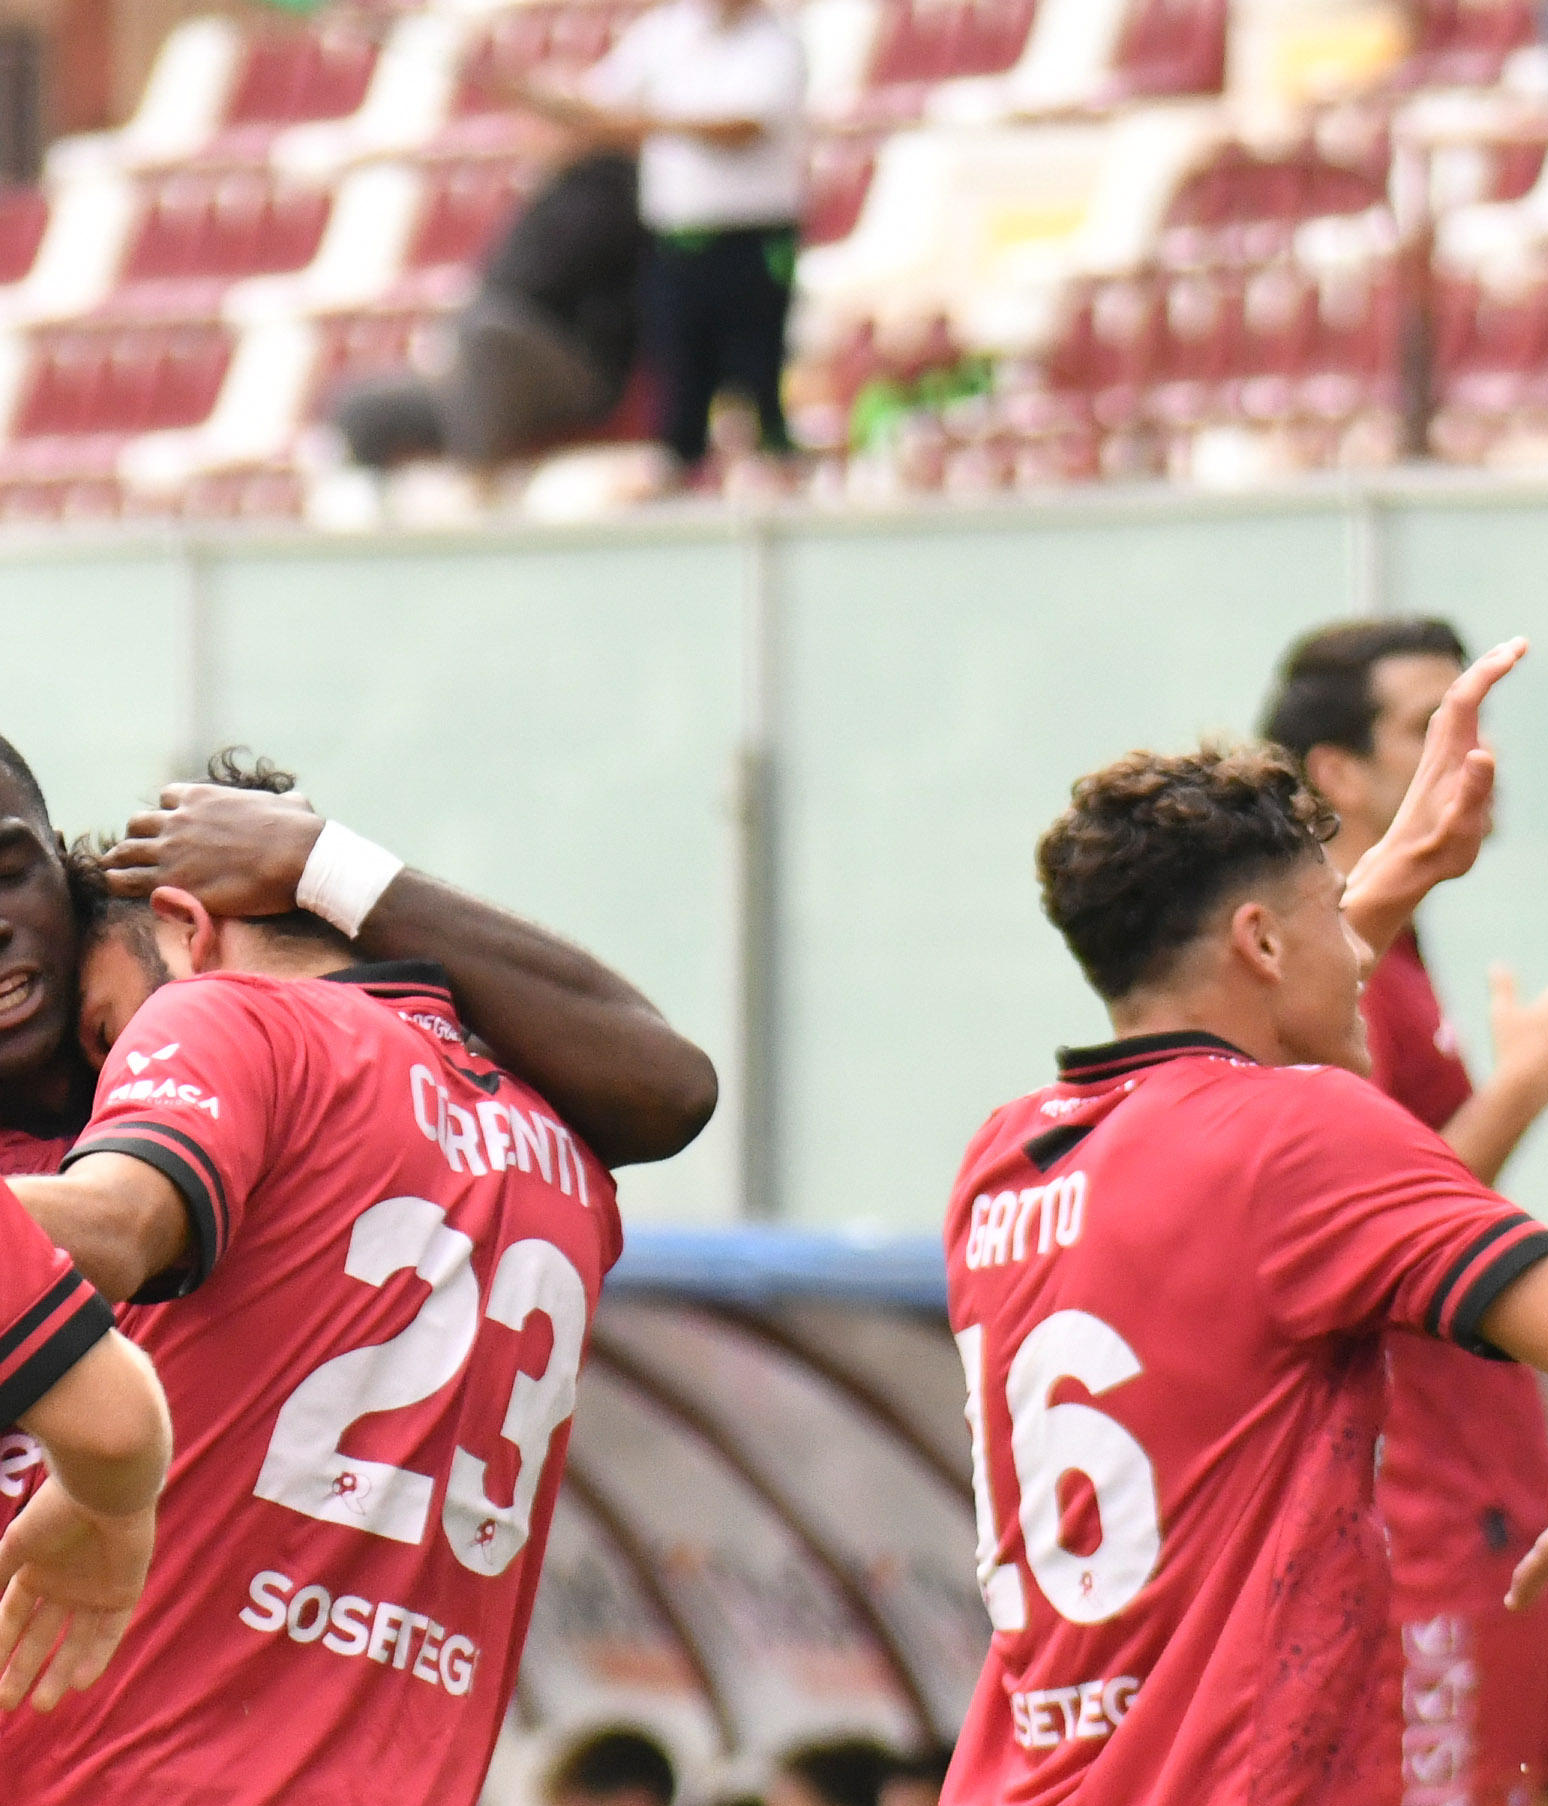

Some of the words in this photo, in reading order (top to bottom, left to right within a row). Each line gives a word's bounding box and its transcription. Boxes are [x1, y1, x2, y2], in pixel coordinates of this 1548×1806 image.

[966, 1170, 1088, 1270] GATTO
[253, 1196, 587, 1577] 23
[954, 1309, 1161, 1633] 16
[238, 1569, 475, 1696] SOSETEG
